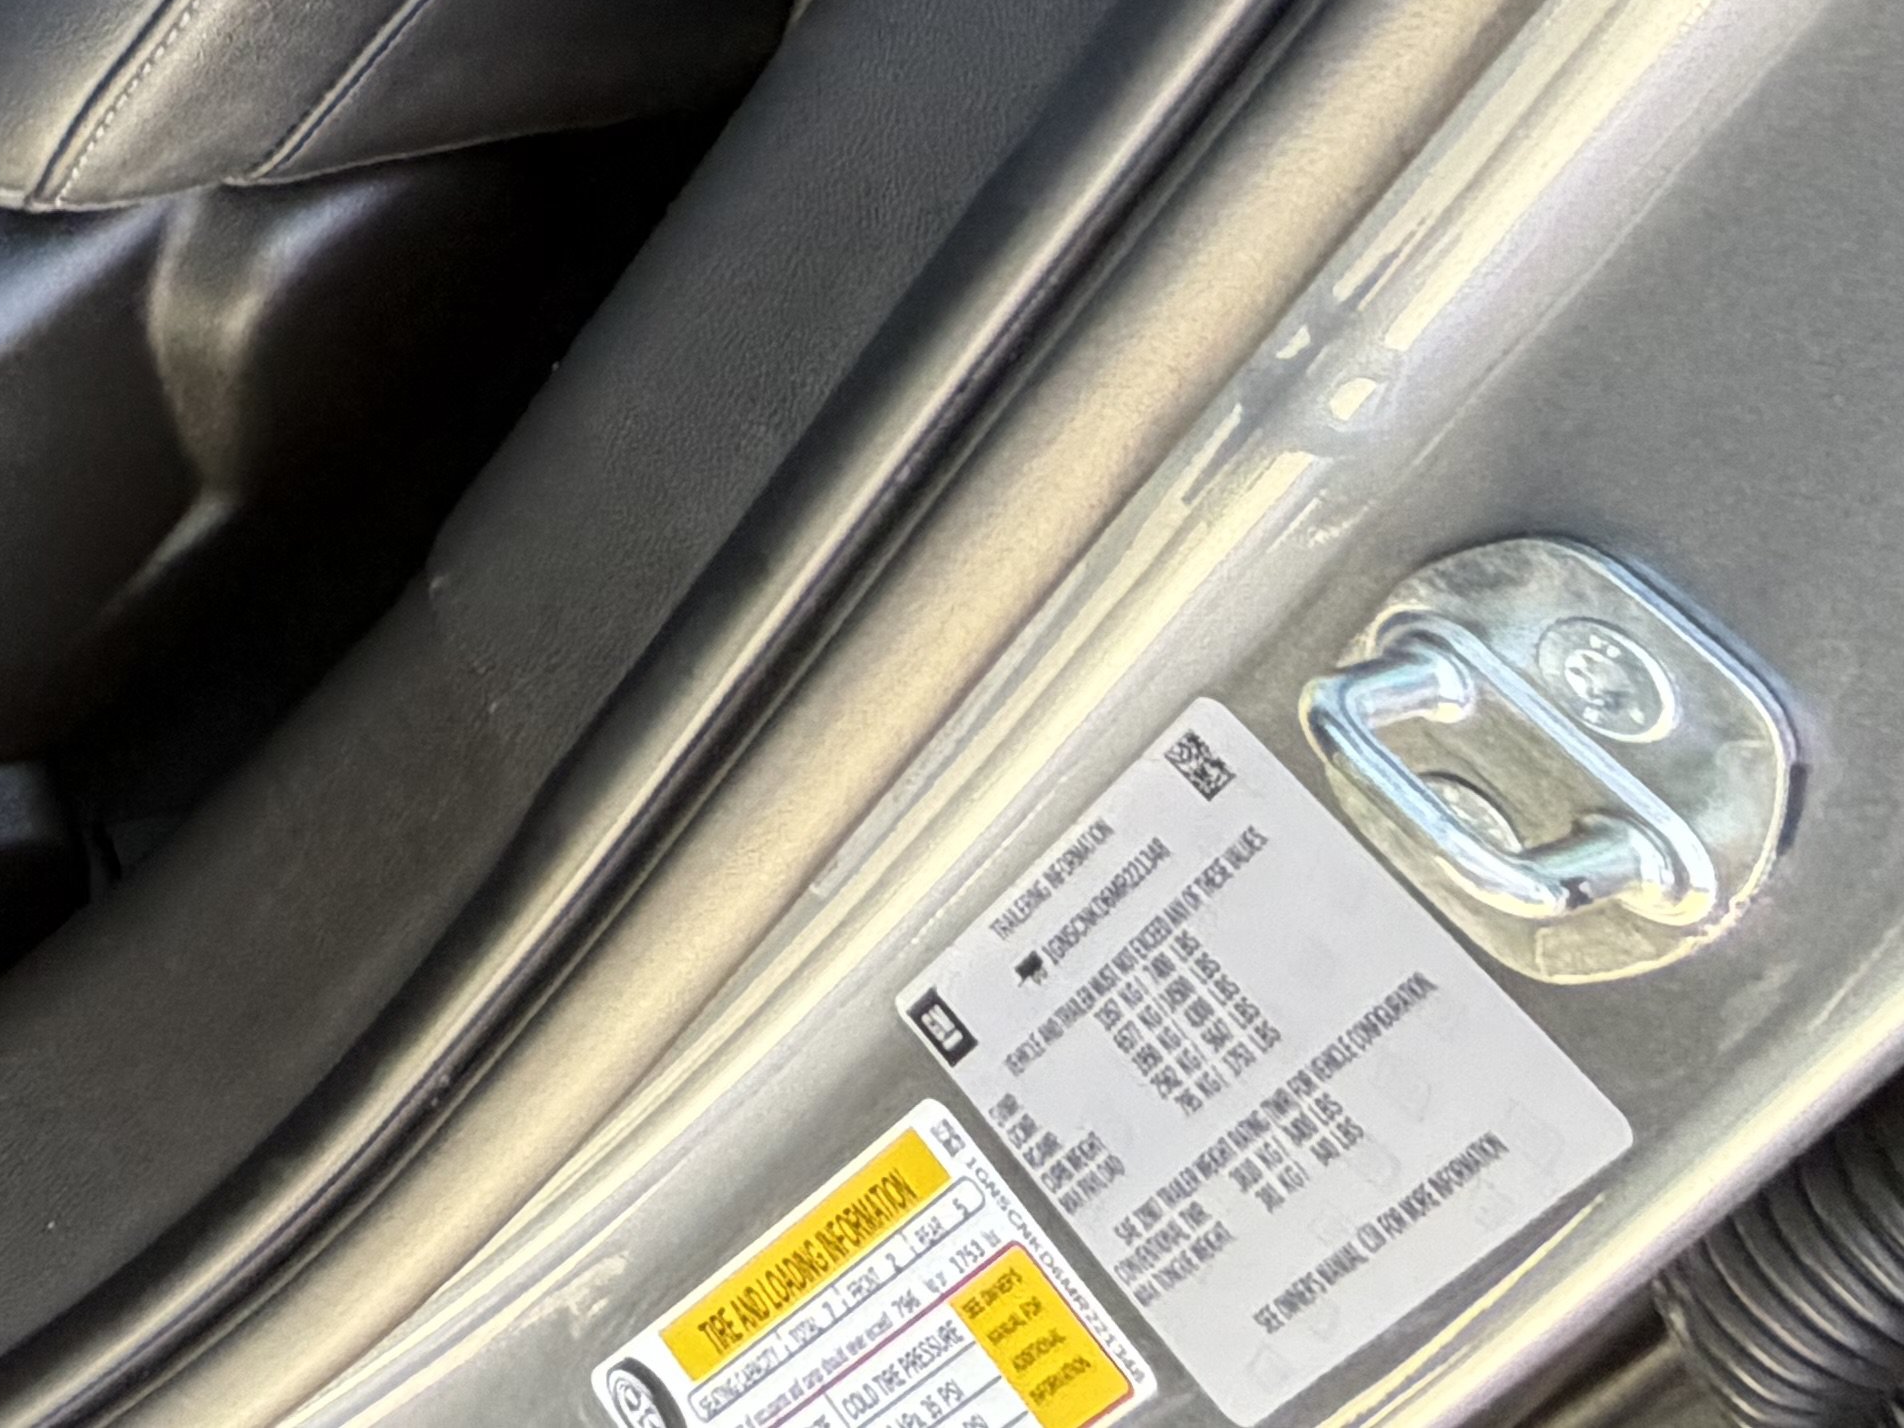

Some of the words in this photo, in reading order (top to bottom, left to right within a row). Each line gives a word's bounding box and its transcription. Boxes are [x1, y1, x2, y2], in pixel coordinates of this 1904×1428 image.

[696, 1305, 744, 1357] TIRE
[726, 1283, 773, 1333] AND
[754, 1235, 831, 1311] LOADING
[812, 1165, 919, 1265] INFORMATION
[839, 1380, 882, 1422] COLD
[896, 1317, 966, 1380] PRESSURE
